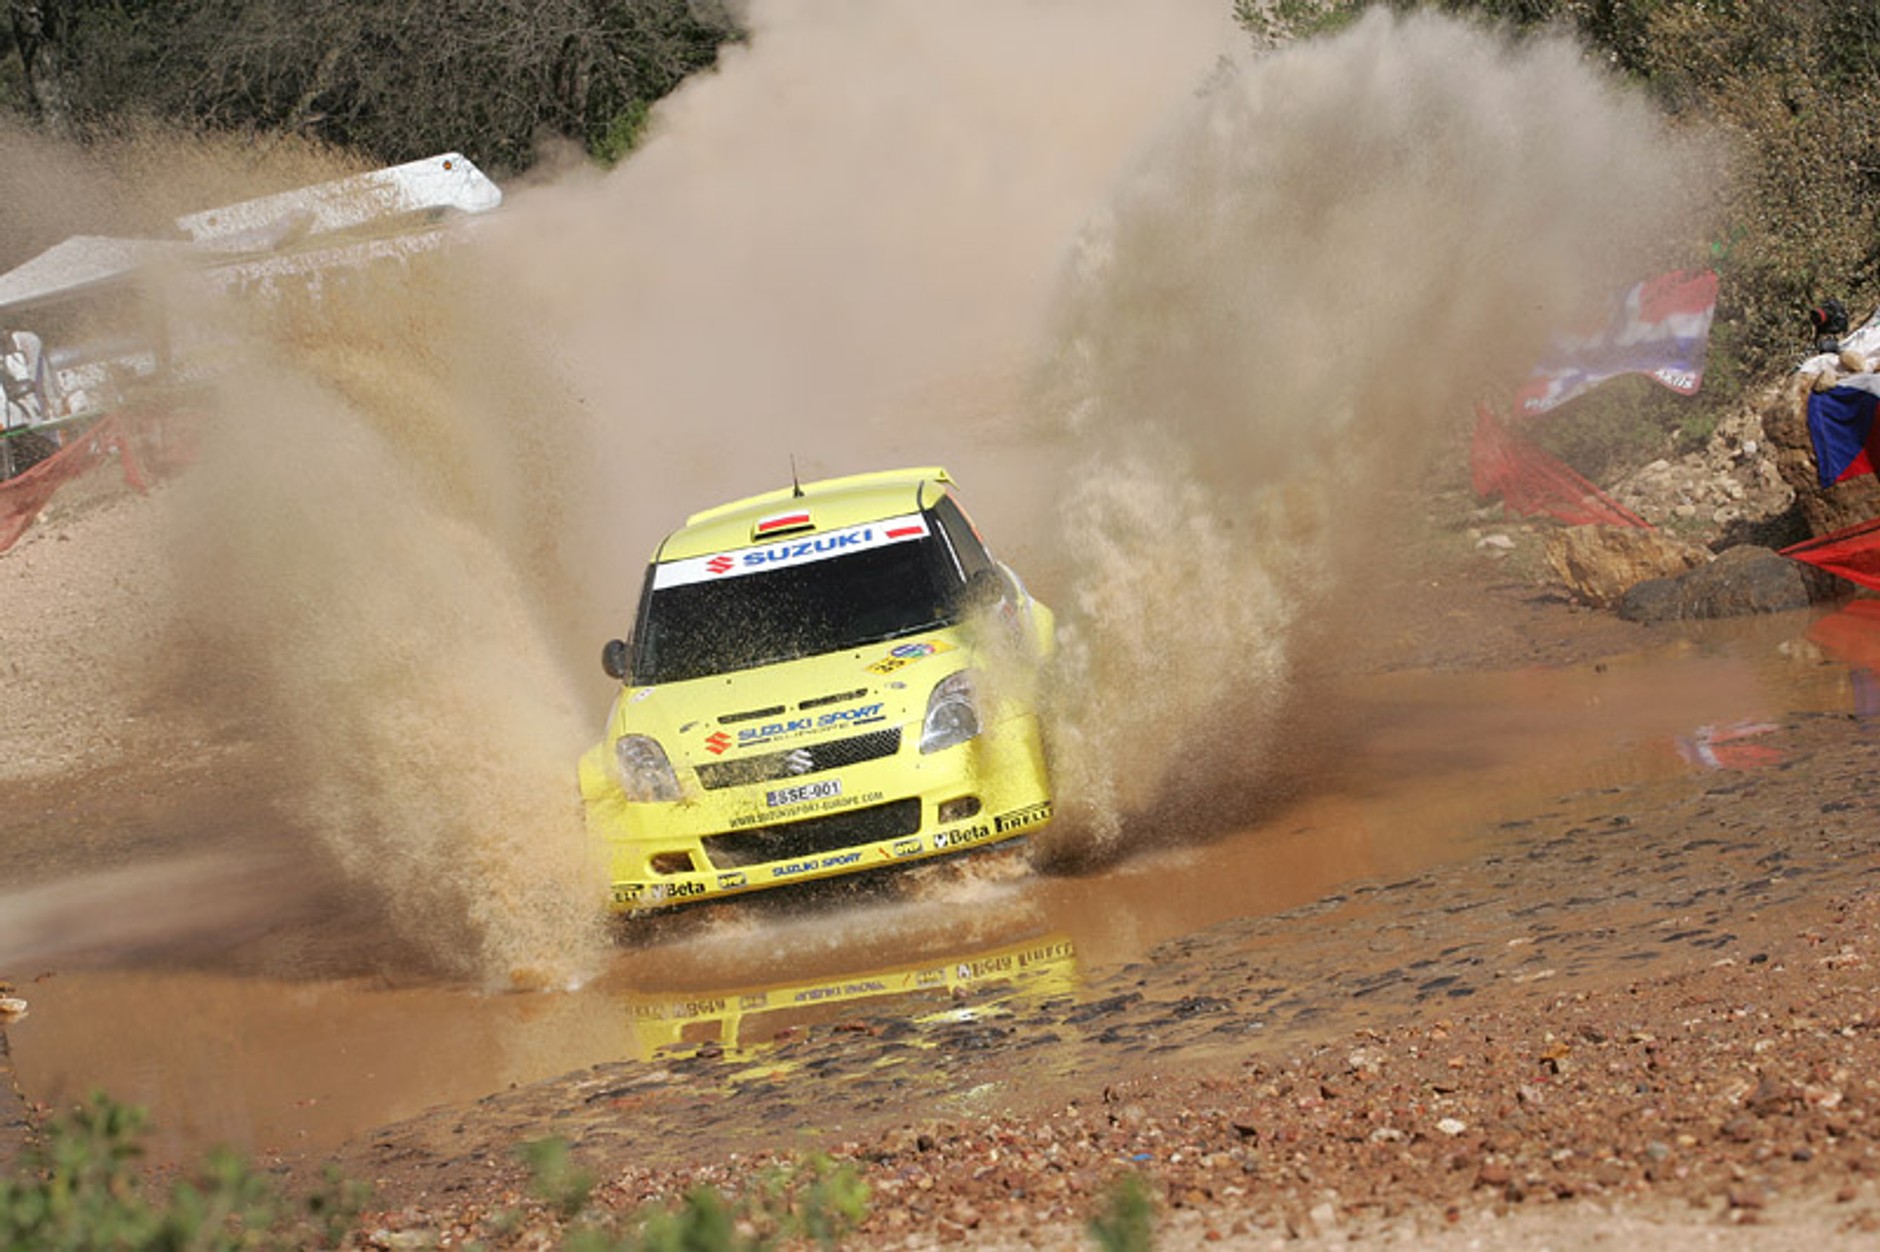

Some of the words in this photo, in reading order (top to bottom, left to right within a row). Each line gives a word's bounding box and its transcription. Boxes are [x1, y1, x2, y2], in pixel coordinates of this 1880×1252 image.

[742, 528, 873, 567] SUZUKI
[737, 718, 813, 742] SUZUKI
[817, 702, 885, 726] SPORT
[949, 825, 990, 844] Beta
[821, 852, 862, 868] SPORT
[667, 881, 706, 897] Beta
